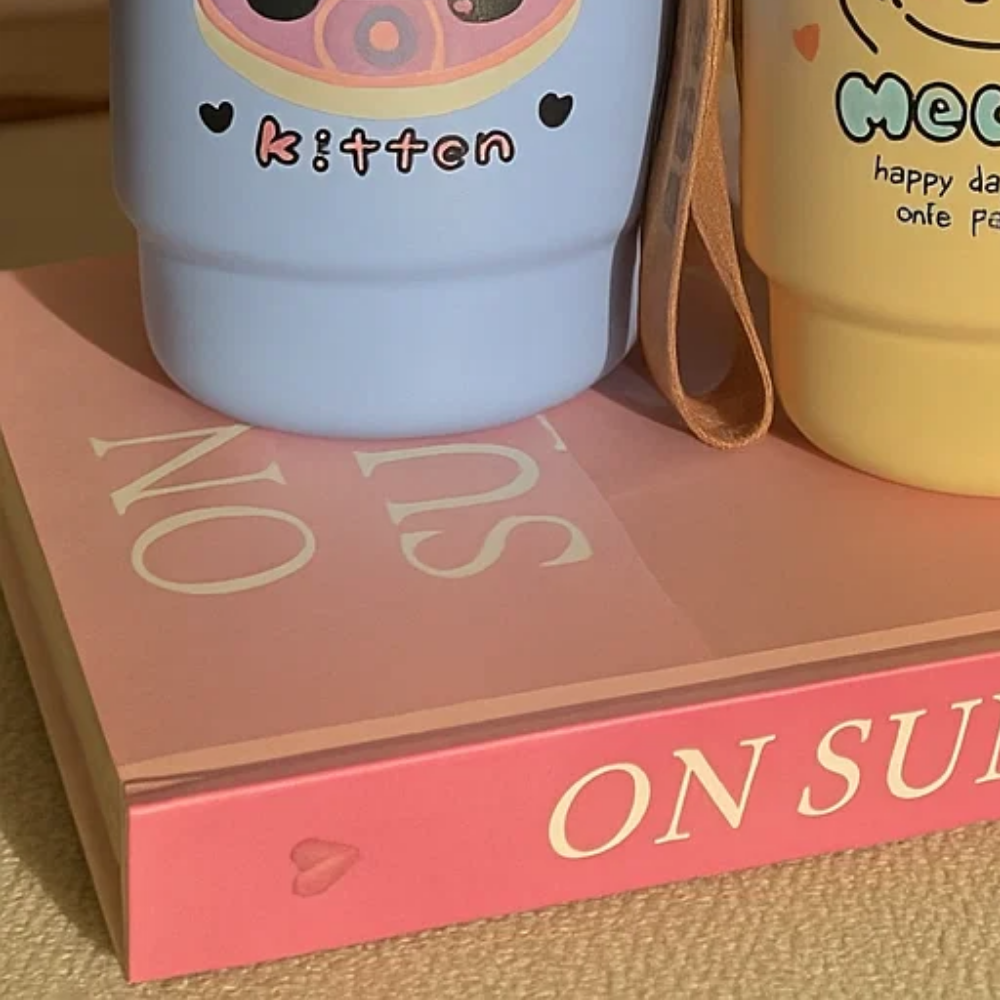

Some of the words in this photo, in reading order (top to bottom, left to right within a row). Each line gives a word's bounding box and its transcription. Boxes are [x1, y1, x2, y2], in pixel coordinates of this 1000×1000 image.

[255, 114, 515, 176] kitten
[874, 155, 954, 197] happy
[89, 423, 316, 595] ON
[547, 734, 776, 861] ON
